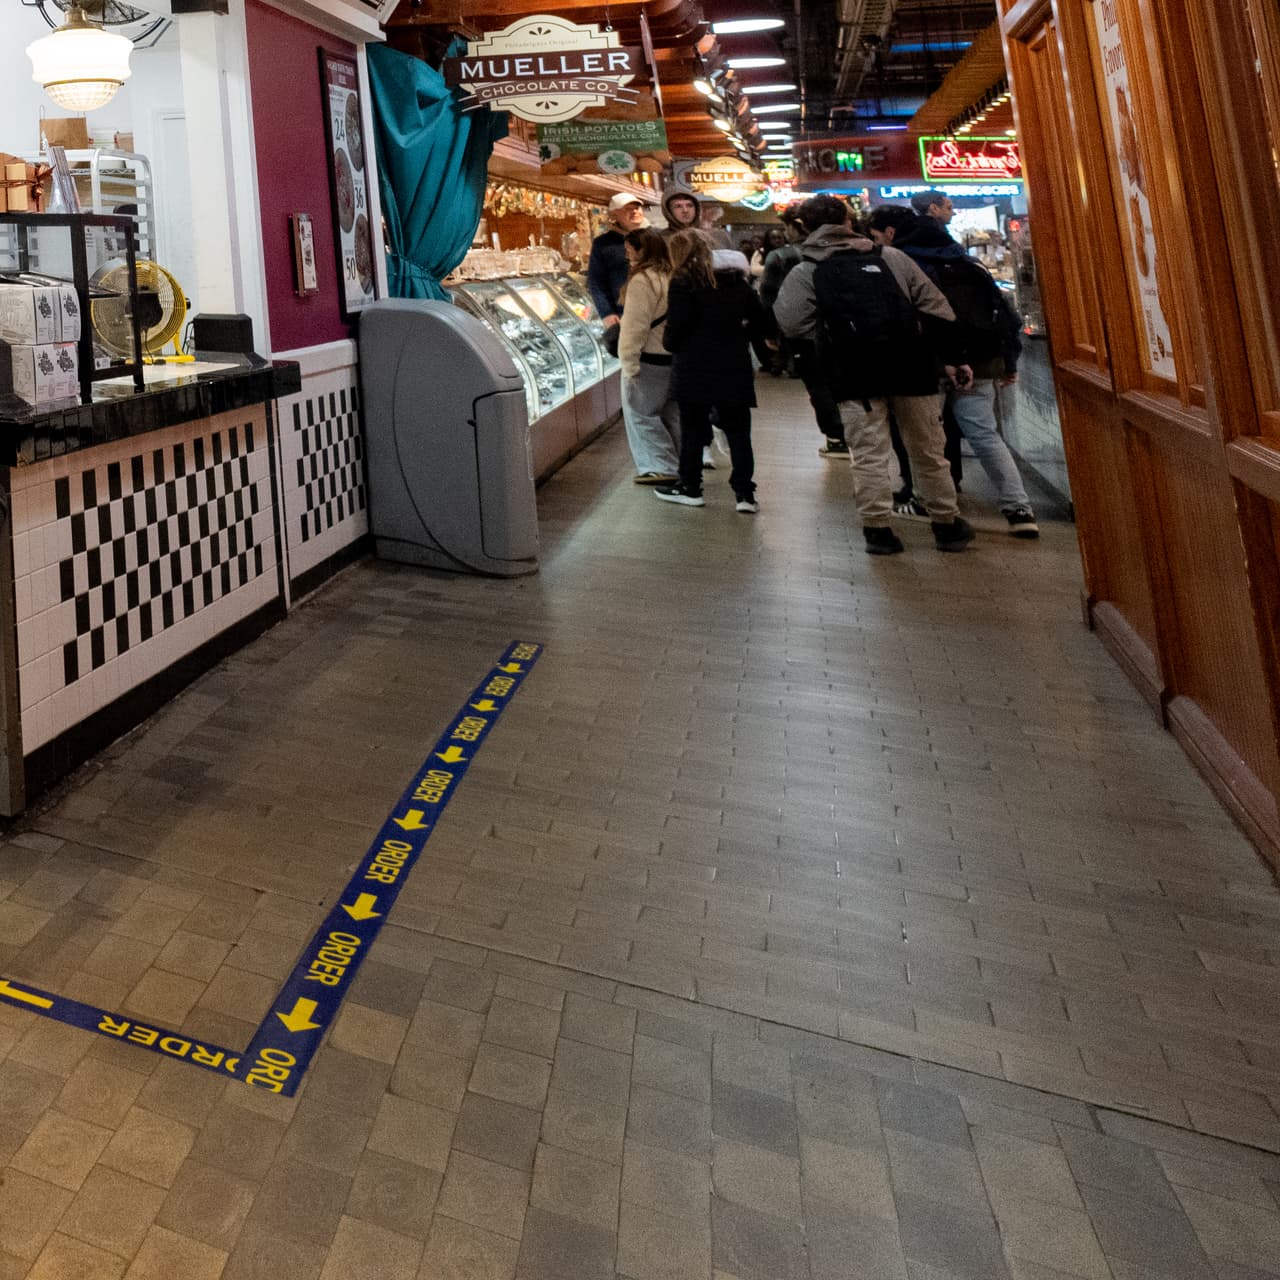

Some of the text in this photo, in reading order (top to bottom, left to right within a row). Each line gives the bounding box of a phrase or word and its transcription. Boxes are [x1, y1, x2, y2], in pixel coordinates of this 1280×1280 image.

[460, 52, 632, 80] MUELLER
[481, 80, 613, 99] CHOCOLATE CO.
[335, 118, 345, 142] 24
[543, 121, 657, 136] IRISH POTATOES
[690, 173, 764, 183] MUELLER
[354, 187, 364, 209] 36
[346, 258, 356, 281] 50
[510, 642, 539, 661] ORDER
[482, 675, 516, 697] ORDER
[450, 716, 488, 742] ORDER
[412, 769, 454, 804] ORDER
[364, 839, 413, 885] ORDER
[304, 931, 361, 987] ORDER
